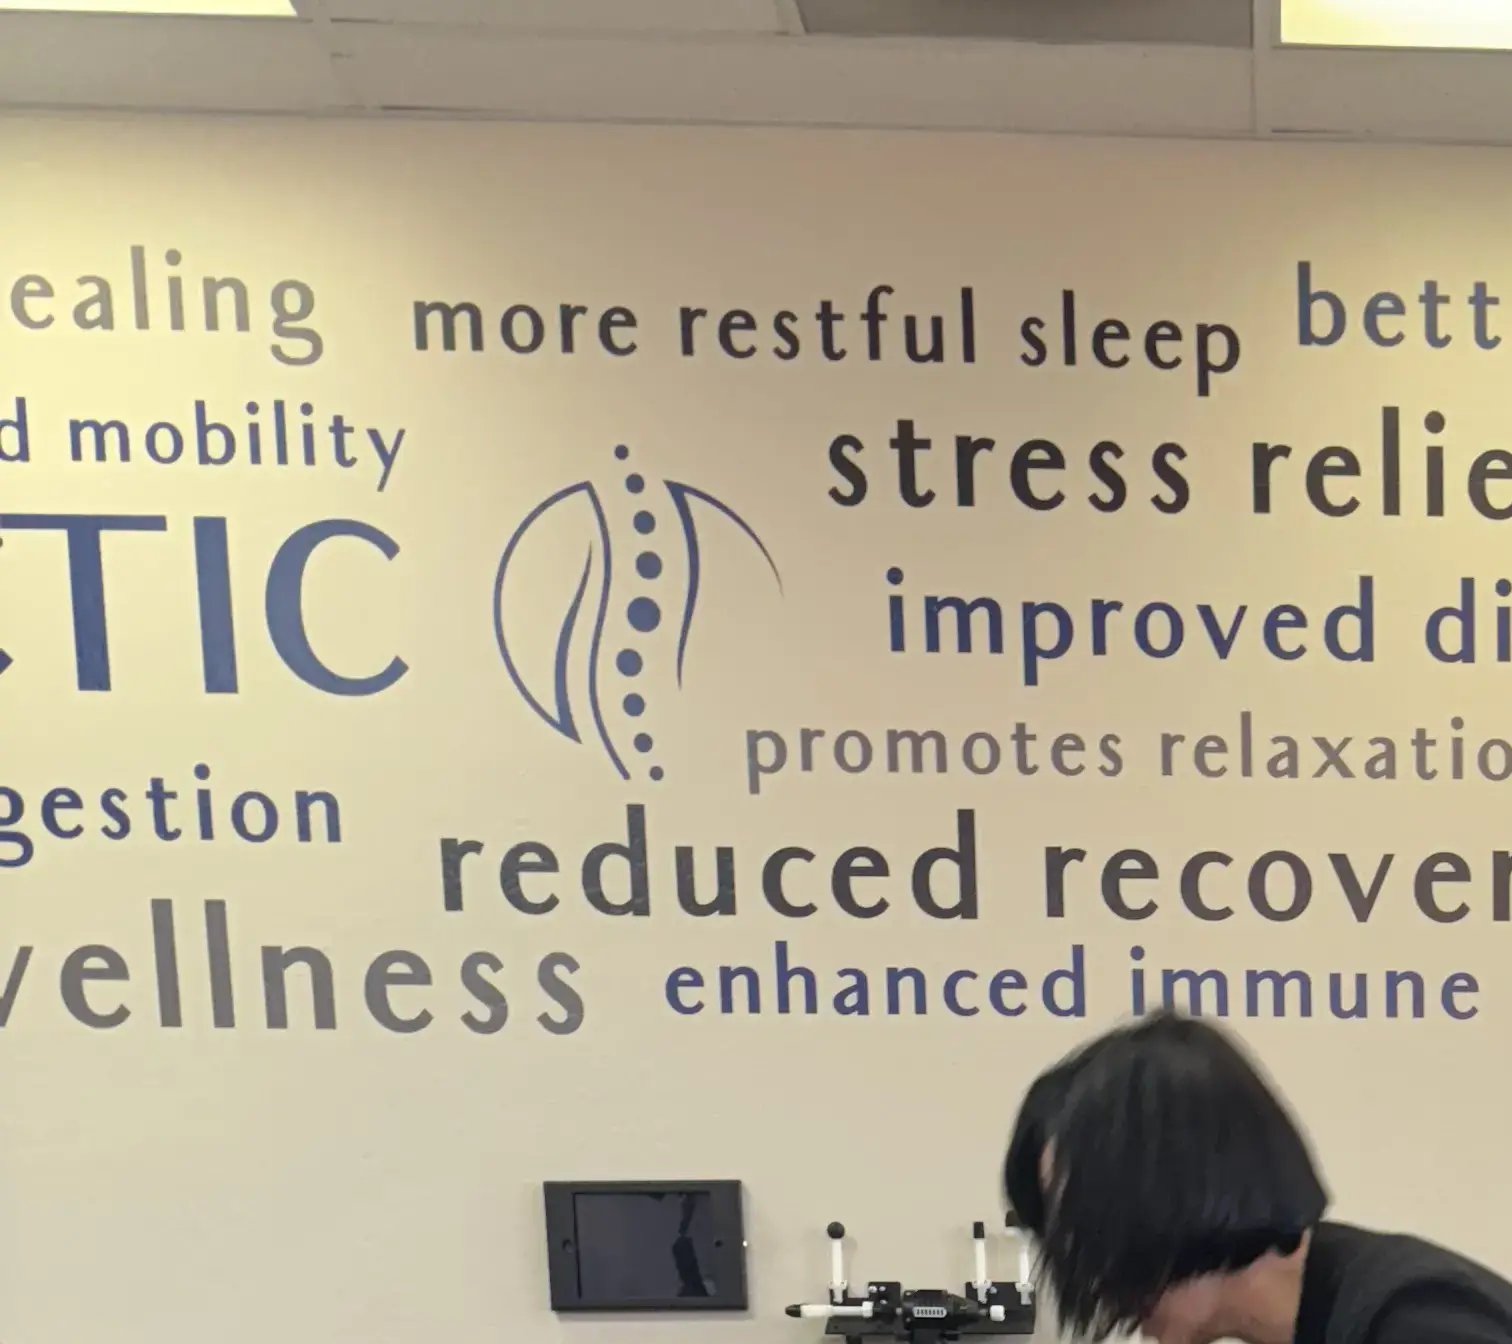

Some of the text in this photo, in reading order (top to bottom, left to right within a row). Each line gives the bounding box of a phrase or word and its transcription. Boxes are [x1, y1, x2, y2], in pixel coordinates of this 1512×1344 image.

[414, 285, 1240, 397] more restful sleep
[69, 400, 405, 492] mobility
[828, 419, 1190, 514] stress
[0, 513, 409, 696] TIC
[886, 567, 1374, 686] improved
[747, 723, 1123, 794] promotes
[440, 804, 978, 919] reduced
[665, 940, 1086, 1017] enhanced
[1130, 945, 1479, 1020] immune
